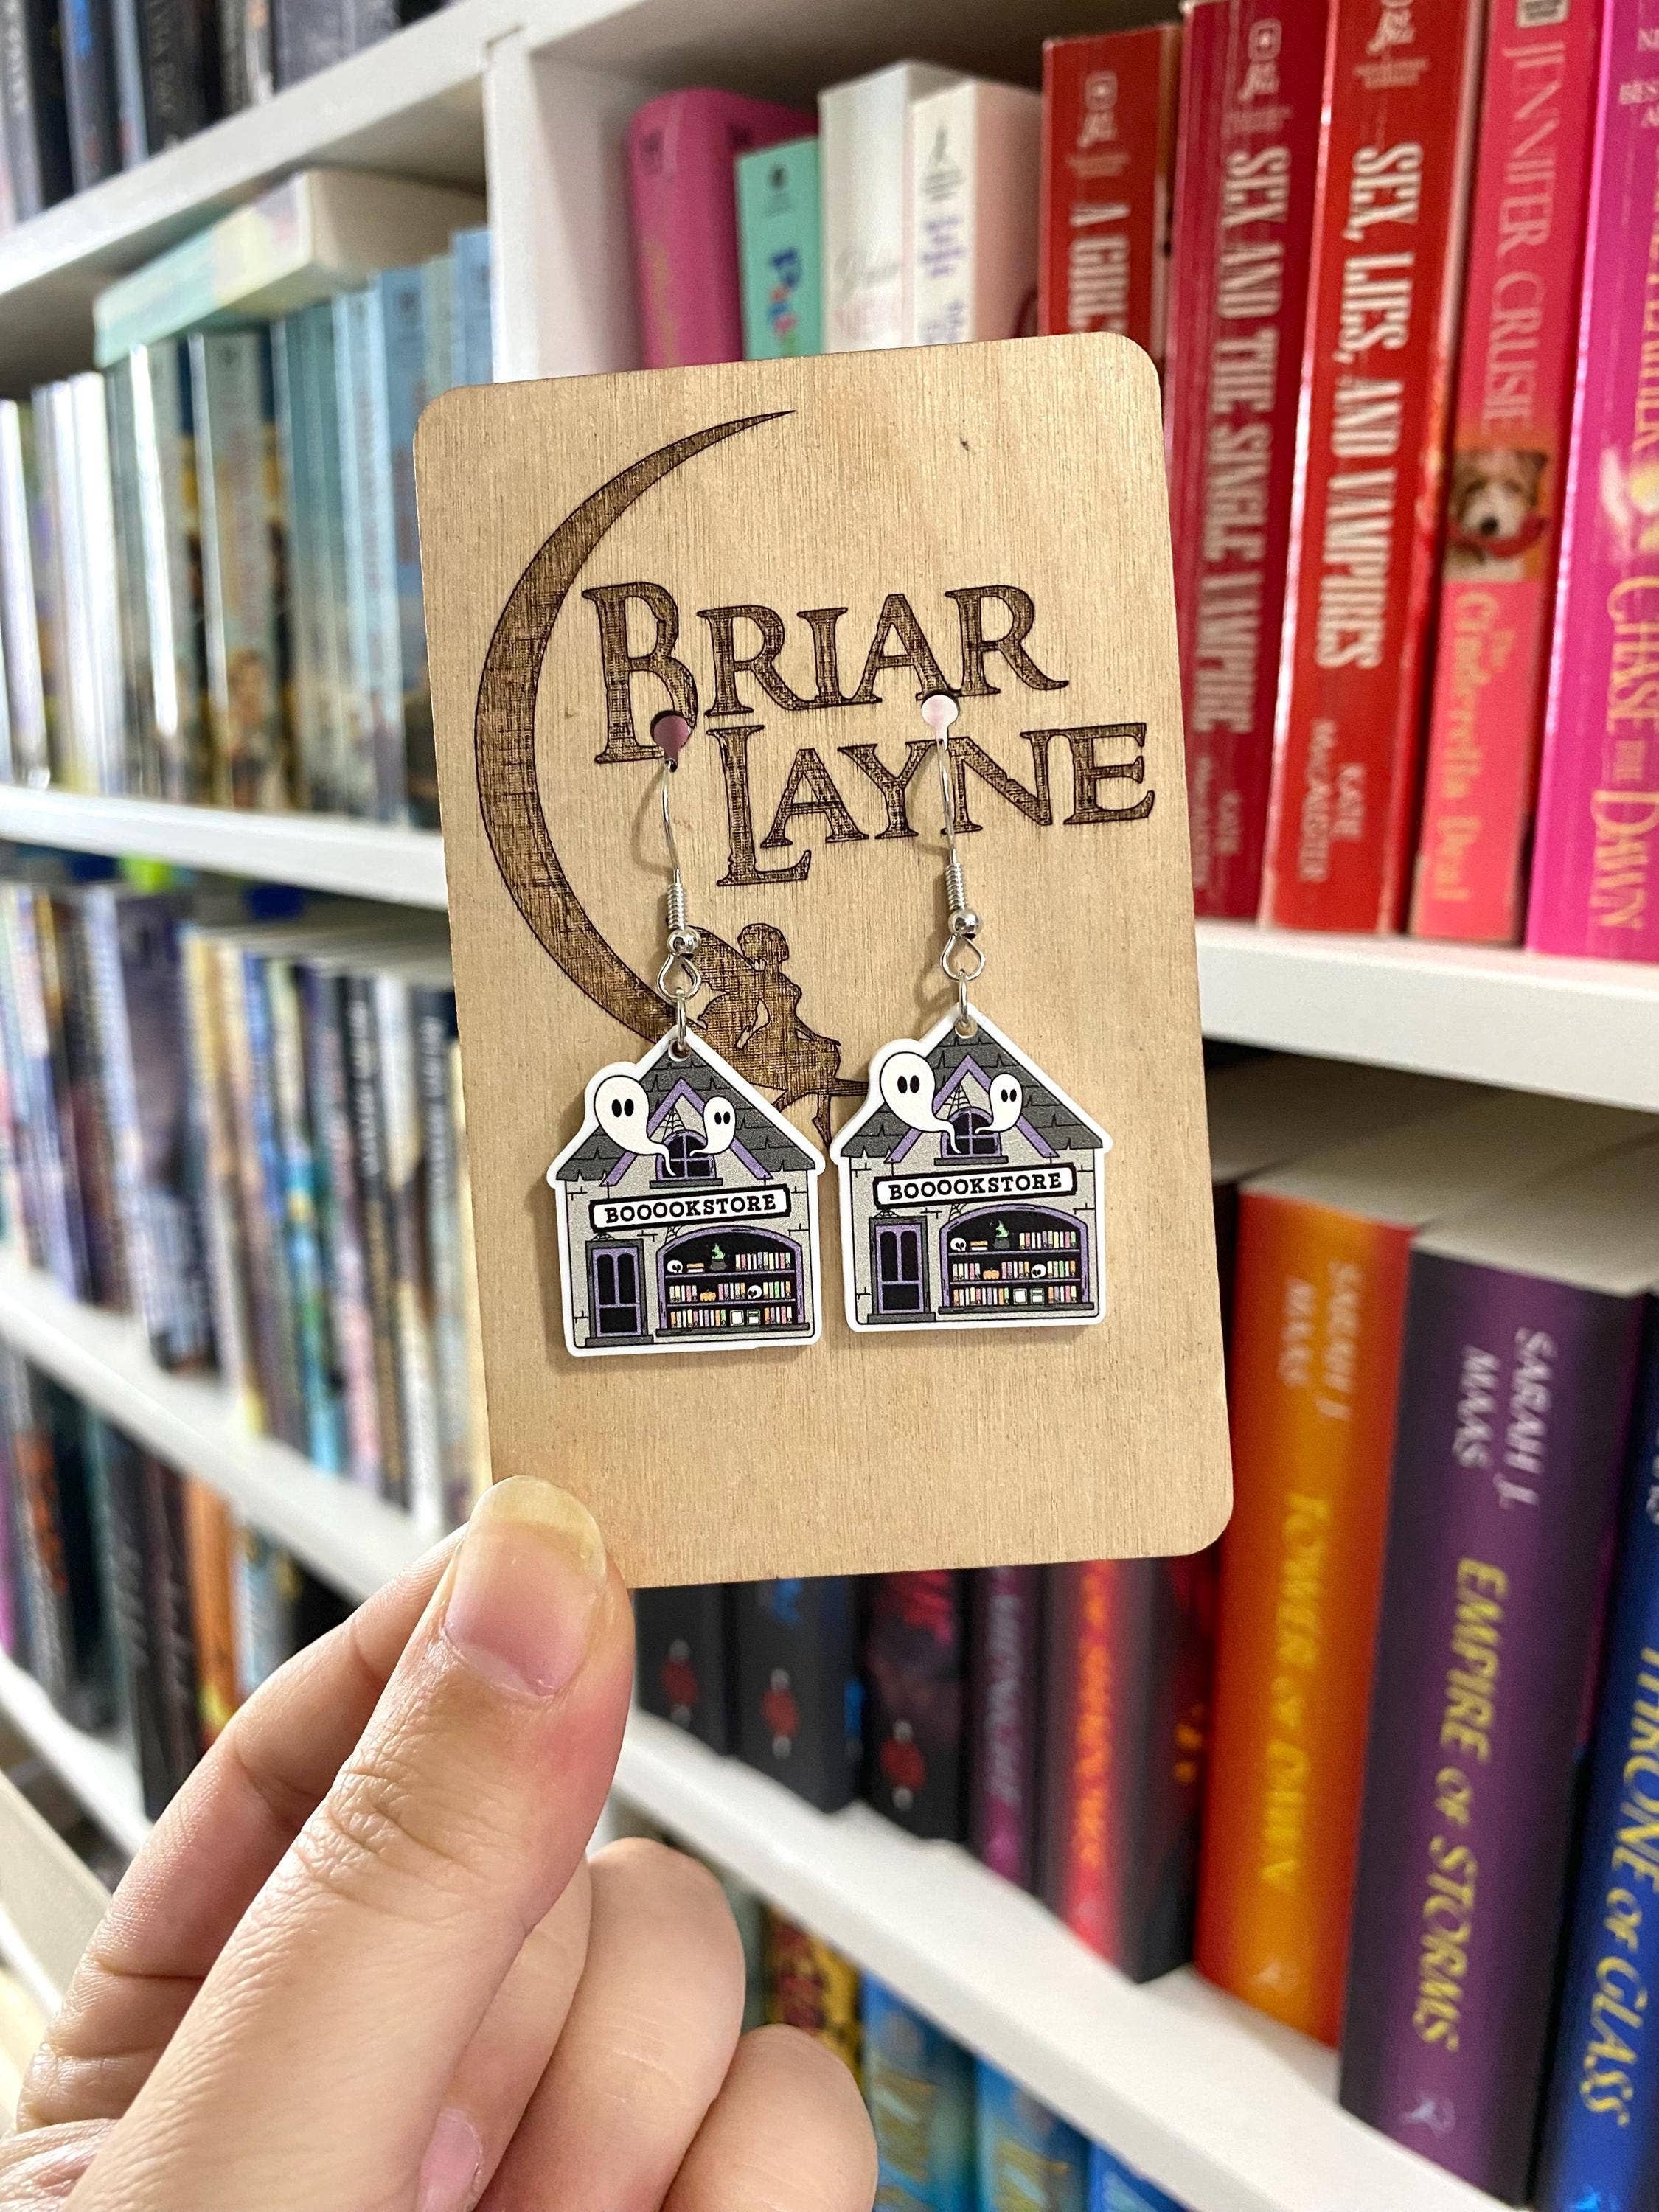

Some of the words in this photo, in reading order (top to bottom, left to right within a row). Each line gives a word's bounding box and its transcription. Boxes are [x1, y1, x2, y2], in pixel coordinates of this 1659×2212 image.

[1223, 147, 1291, 230] SEX
[1498, 41, 1566, 260] JENNIFER
[1219, 242, 1284, 318] AND
[1483, 271, 1543, 437] CRUSIE
[1213, 328, 1278, 414] THE
[1331, 378, 1404, 459] AND
[1317, 469, 1397, 669] VAMPIRES
[582, 581, 1070, 765] BRIAR
[1192, 571, 1264, 734] VAMPIRE
[706, 722, 1155, 887] LAYNE
[603, 1193, 776, 1224] BOOOOKSTORE
[888, 1172, 1062, 1200] BOOOOKSTORE
[1453, 1345, 1501, 1469] MAAS
[1505, 1326, 1557, 1472] SARAH
[1441, 1557, 1510, 1762] EMPIRE
[1413, 1835, 1478, 2052] STORMS
[1581, 1957, 1649, 2126] GLASS
